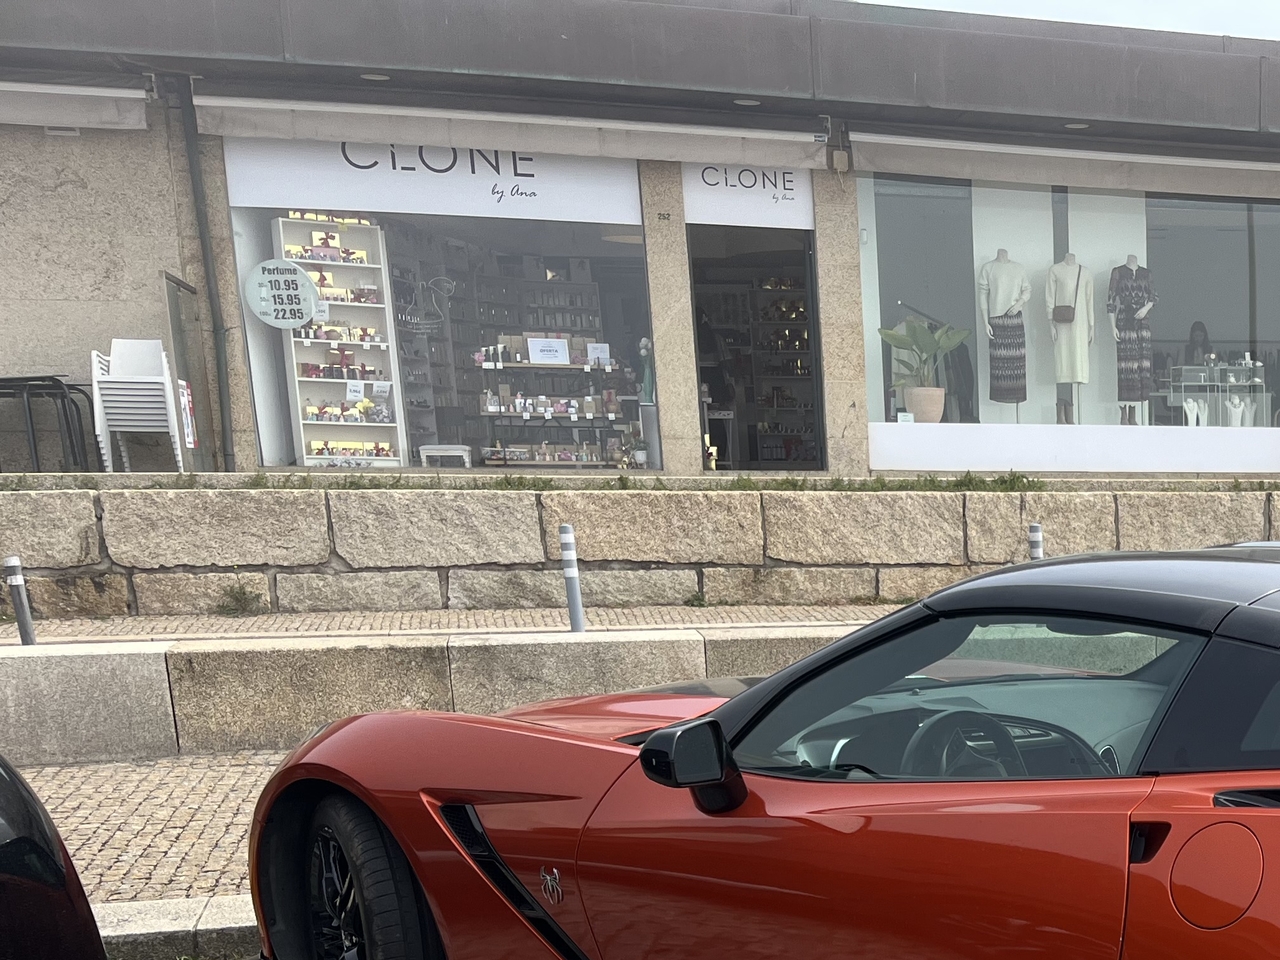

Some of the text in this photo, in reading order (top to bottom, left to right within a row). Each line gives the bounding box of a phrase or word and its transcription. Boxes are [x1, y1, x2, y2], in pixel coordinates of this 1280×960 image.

[340, 141, 535, 178] CLONE
[701, 166, 794, 191] CLONE
[510, 183, 538, 198] Ana
[657, 212, 671, 221] 252
[261, 266, 298, 276] Perfume
[267, 279, 299, 291] 10.95
[271, 293, 301, 306] 15.95
[273, 308, 304, 320] 22.95
